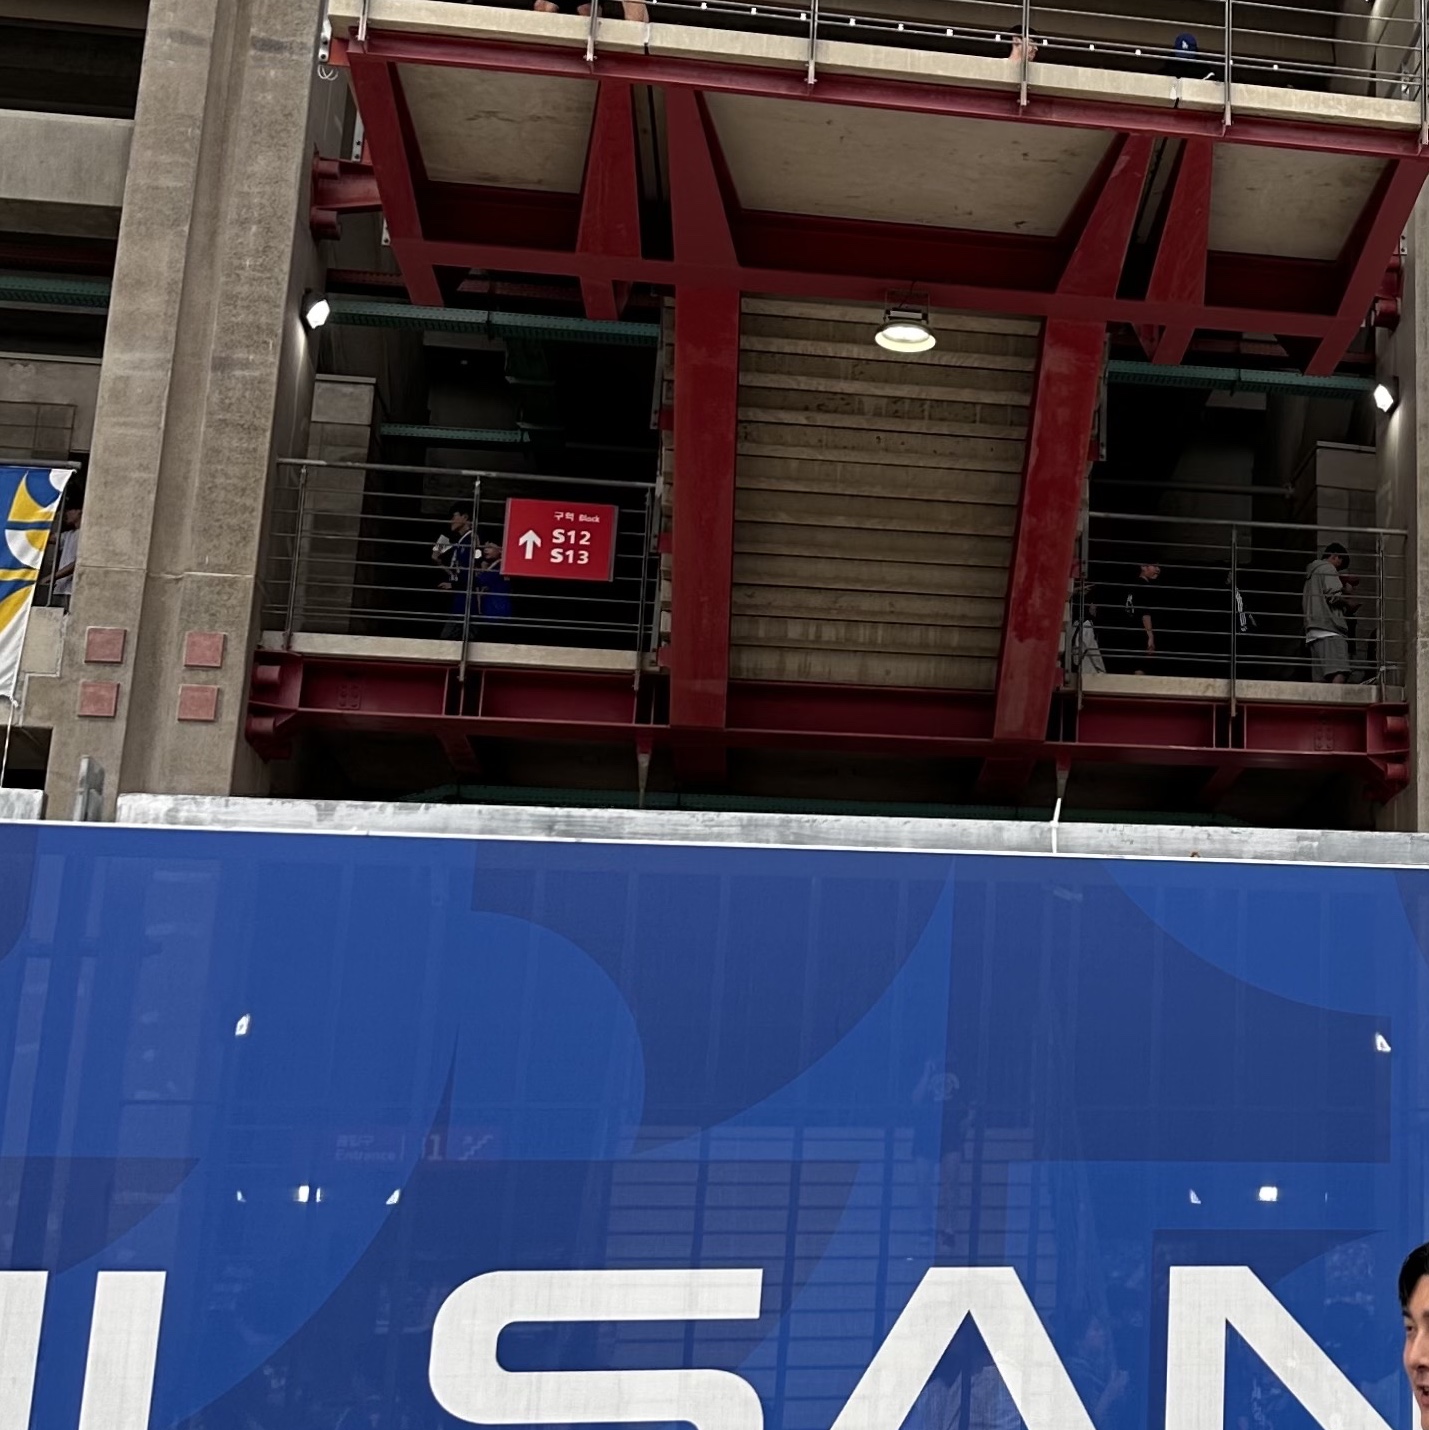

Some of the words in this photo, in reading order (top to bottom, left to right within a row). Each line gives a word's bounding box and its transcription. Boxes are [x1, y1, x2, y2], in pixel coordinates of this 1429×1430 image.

[554, 511, 575, 522] 구역
[579, 514, 600, 523] Block
[552, 528, 591, 545] S12
[550, 548, 589, 564] S13
